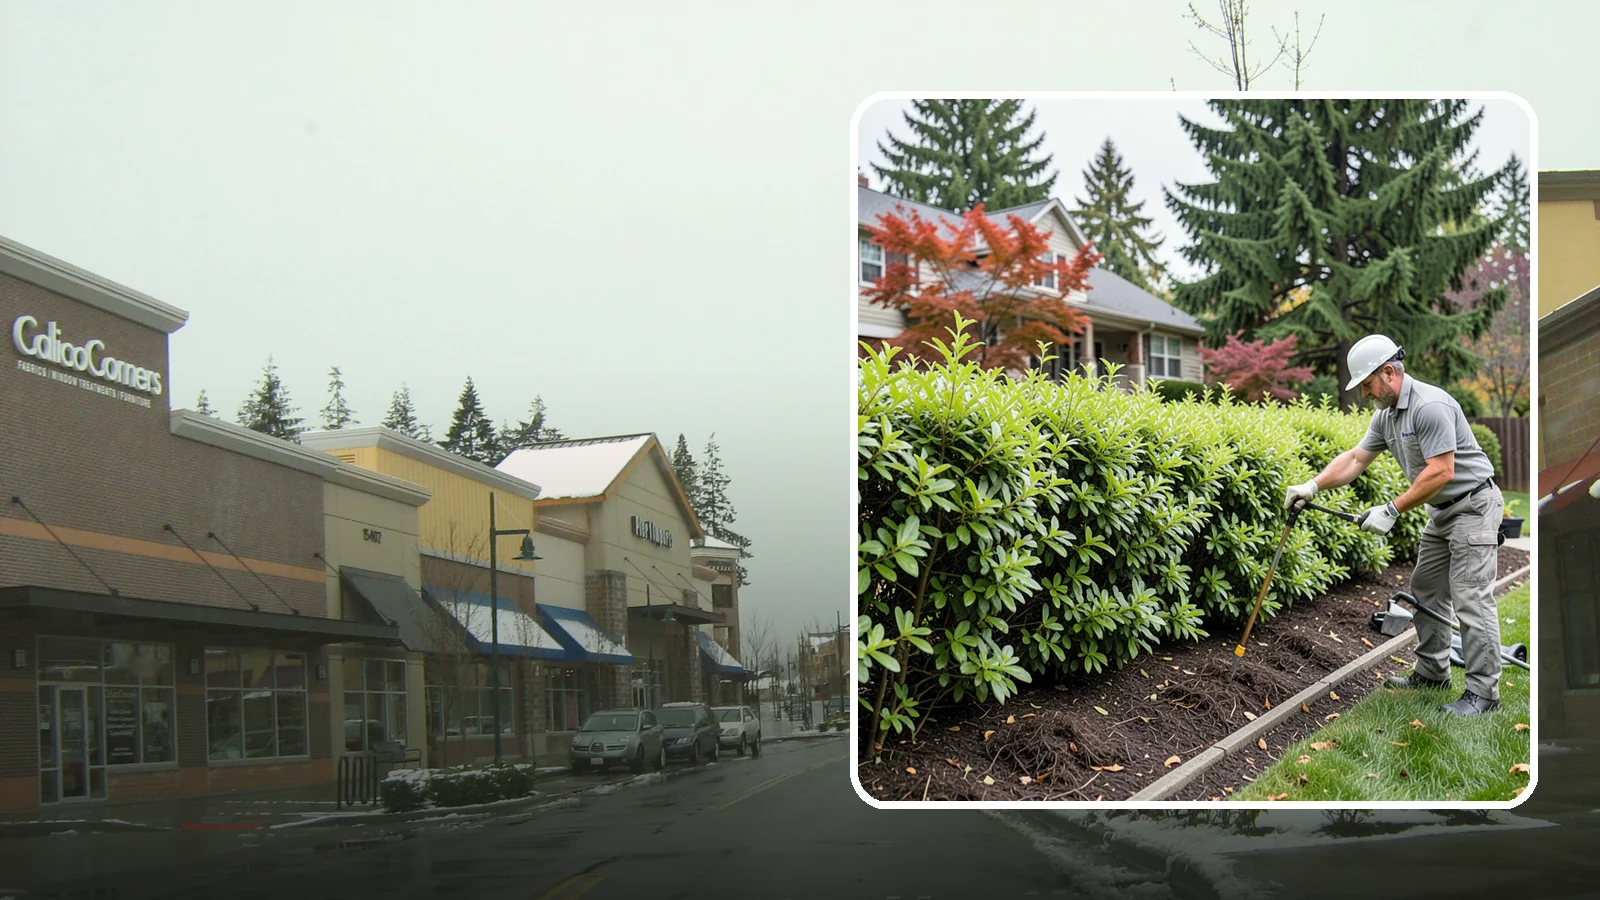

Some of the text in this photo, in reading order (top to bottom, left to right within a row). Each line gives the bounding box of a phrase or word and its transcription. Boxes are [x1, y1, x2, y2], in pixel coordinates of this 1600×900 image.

[16, 360, 151, 409] FABRICS WINDOW TREATMENTS FURNITURE
